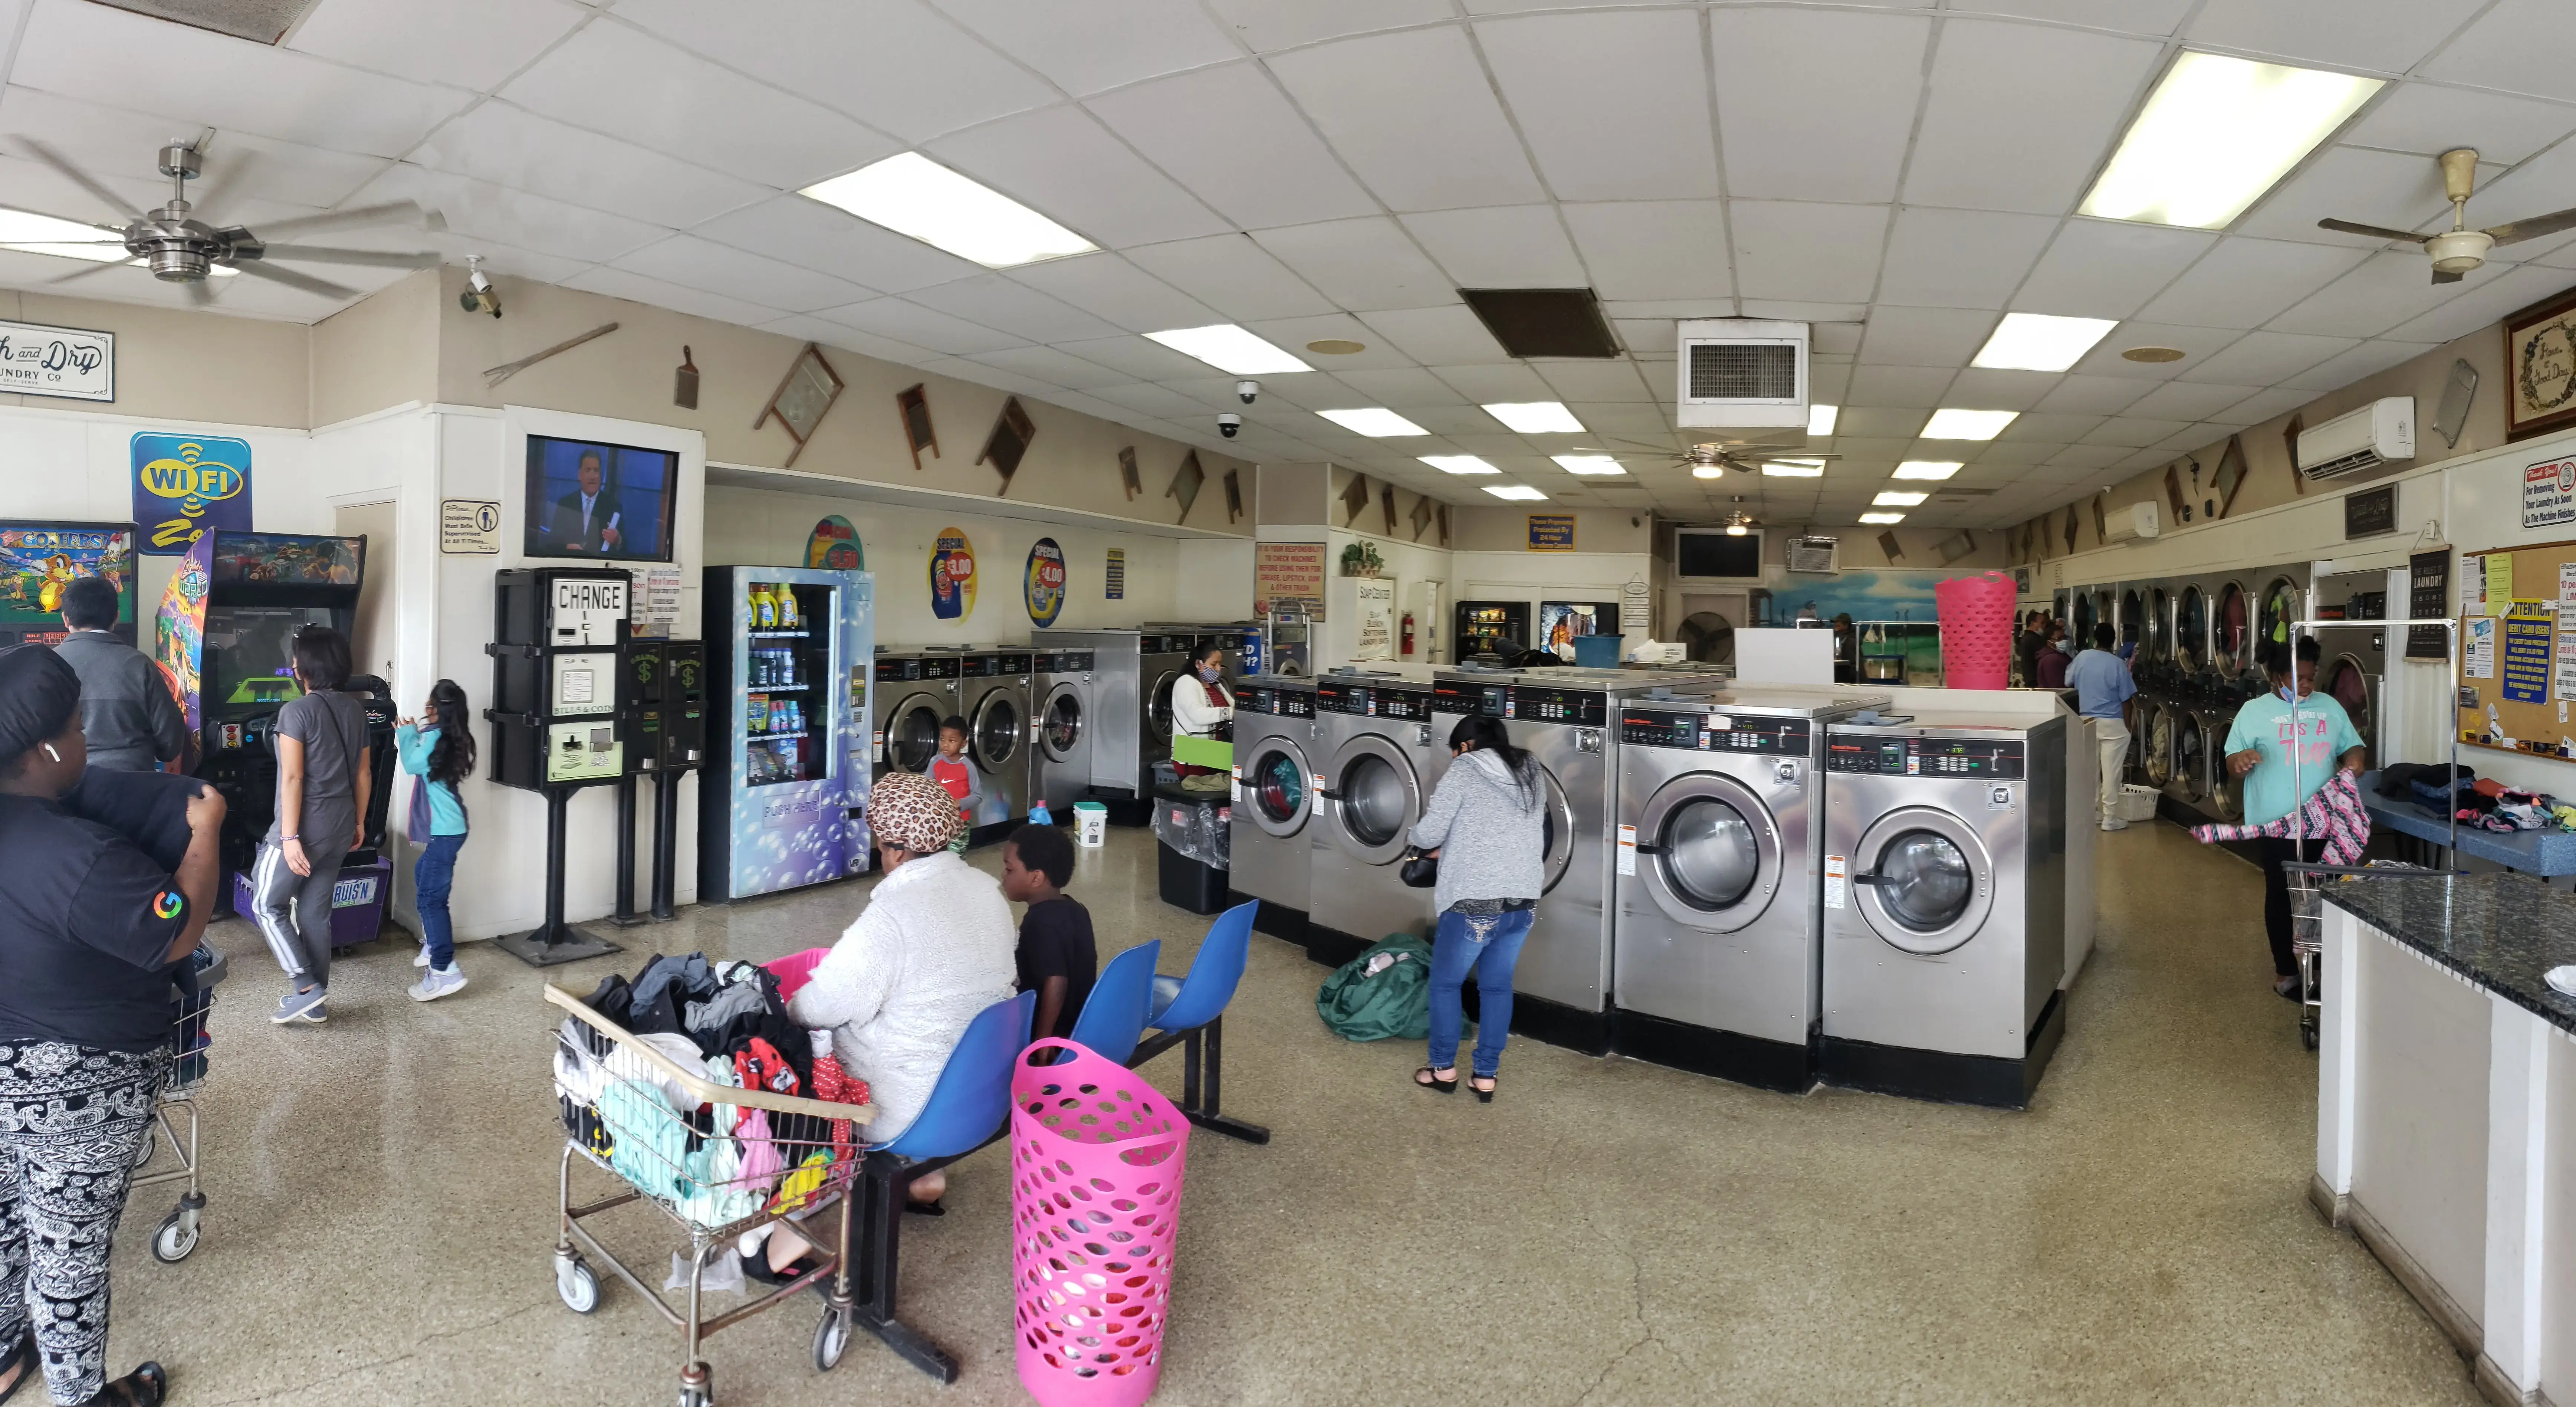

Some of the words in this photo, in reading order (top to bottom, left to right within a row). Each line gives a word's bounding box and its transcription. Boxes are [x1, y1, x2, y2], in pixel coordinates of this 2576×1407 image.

[0, 335, 14, 360] h
[19, 347, 42, 358] and
[41, 341, 102, 375] Dry
[2528, 468, 2543, 479] Thank
[2534, 482, 2555, 494] Removing
[2526, 501, 2535, 509] Your
[2536, 497, 2554, 508] Laundry
[2554, 495, 2560, 505] As
[2561, 494, 2572, 504] Soon
[2525, 515, 2530, 524] As
[2540, 511, 2556, 522] Machine
[2557, 508, 2576, 519] Finishes
[151, 518, 203, 547] Zo
[1035, 545, 1059, 559] SPECIAL
[1041, 567, 1062, 583] $4.00
[2414, 575, 2442, 588] LAUNDRY
[559, 585, 621, 610] CHANGE
[2298, 711, 2316, 720] ROW
[2317, 712, 2327, 720] UP
[2316, 720, 2326, 736] A
[765, 804, 791, 817] PUSH
[794, 800, 818, 813] HERE
[334, 882, 369, 902] RUIS'N
